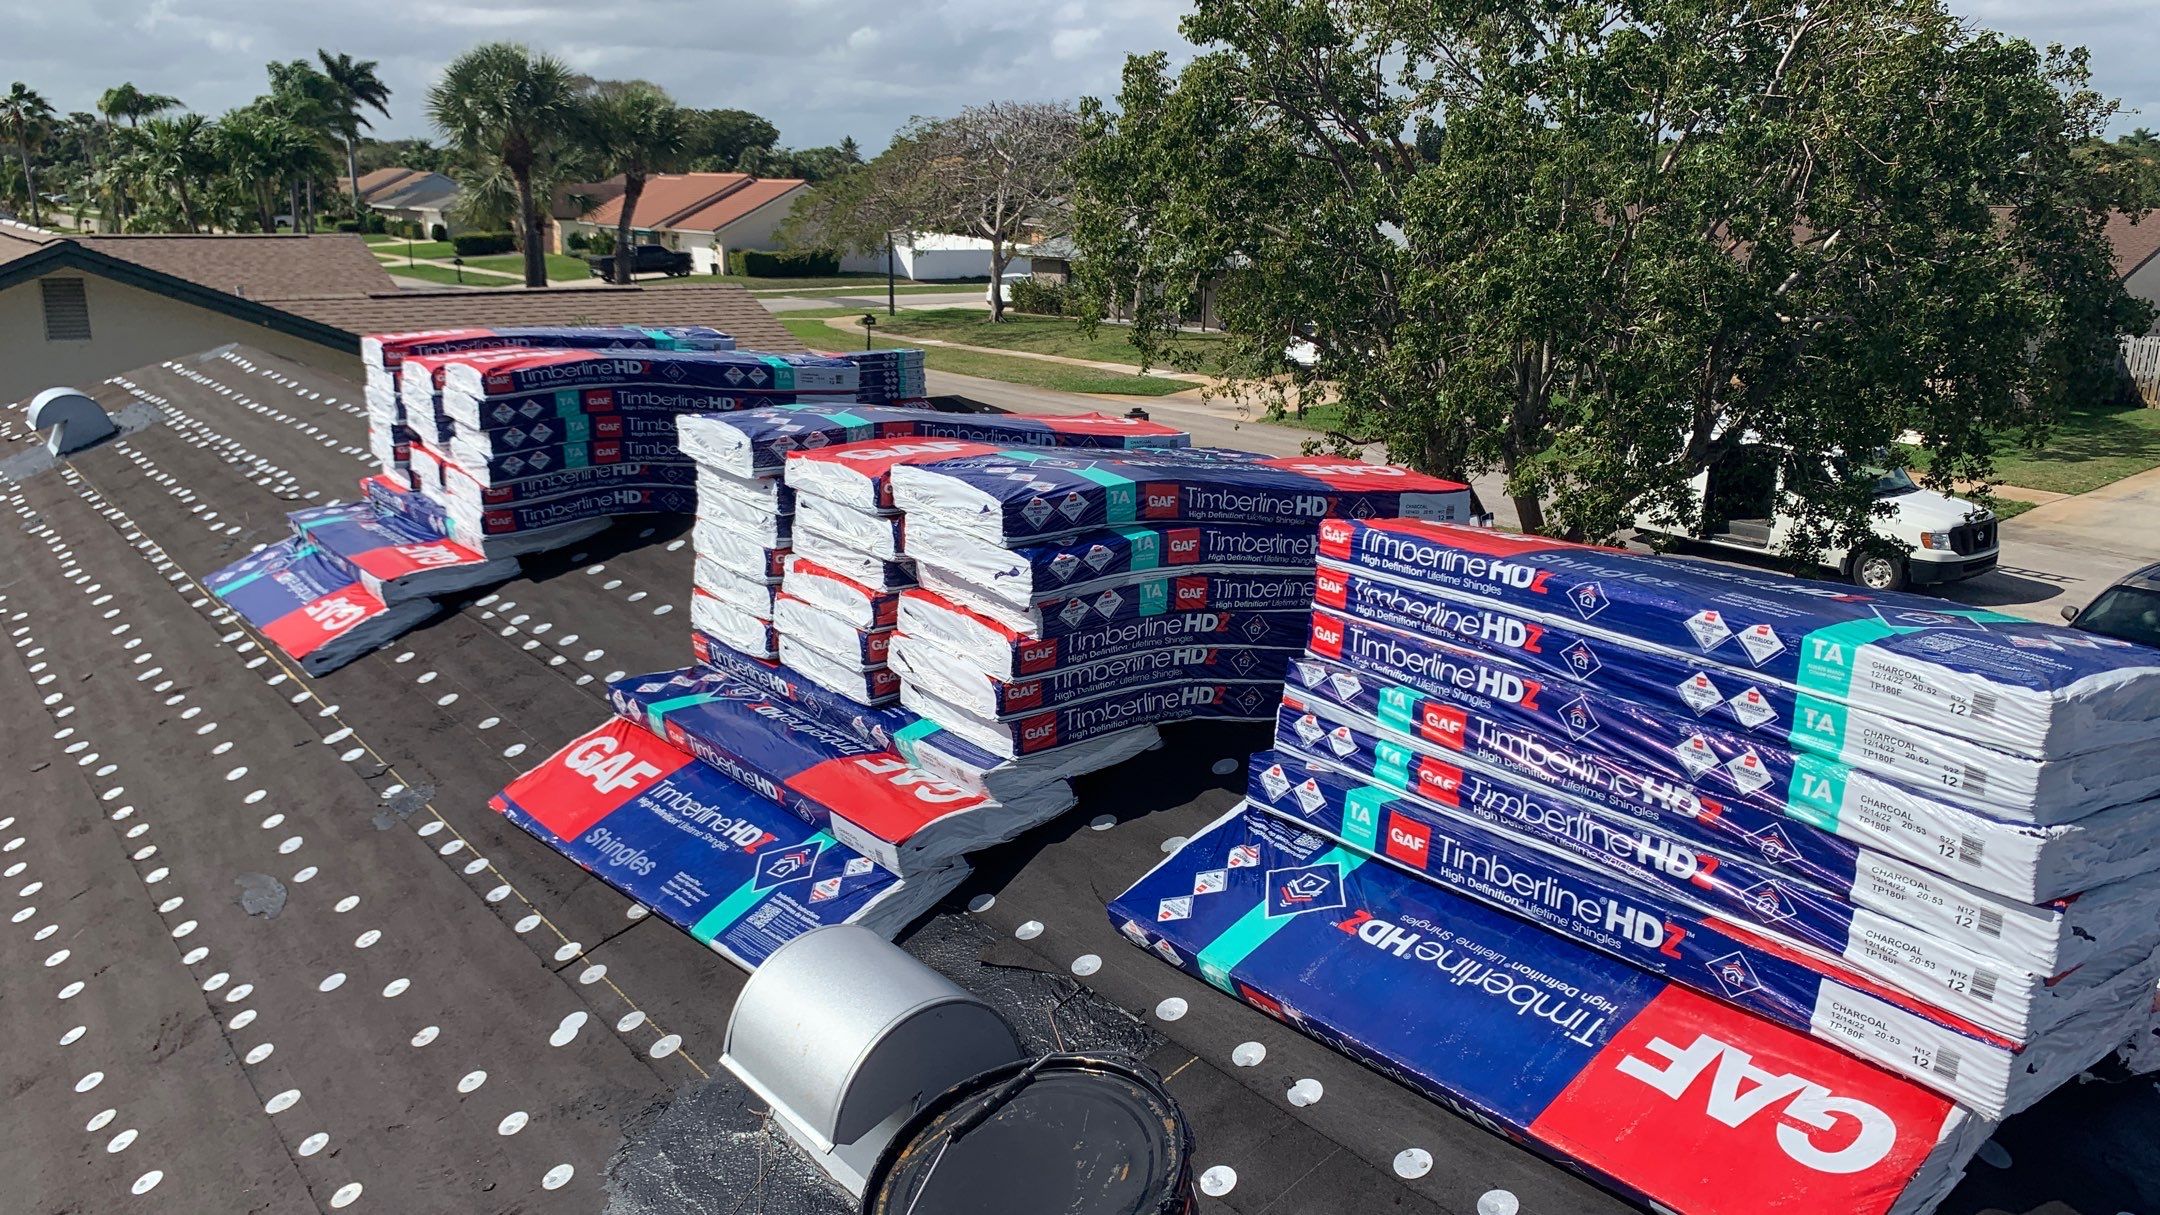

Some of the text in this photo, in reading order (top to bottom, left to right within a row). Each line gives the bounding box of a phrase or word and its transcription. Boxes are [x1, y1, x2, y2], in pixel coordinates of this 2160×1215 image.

[588, 397, 612, 406] GAF
[598, 424, 620, 432] GAF
[597, 448, 618, 457] GAF
[835, 441, 970, 461] GAF
[1111, 491, 1131, 505] TA
[1148, 495, 1176, 508] GAF
[489, 516, 513, 526] GAF
[1171, 540, 1197, 552] GAF
[1322, 526, 1349, 545] GAF
[1361, 553, 1380, 567] High
[1463, 577, 1502, 596] Shingles
[1529, 553, 1681, 588] Shingles
[1144, 584, 1163, 599] TA
[1179, 588, 1205, 600] GAF
[1318, 577, 1345, 595] GAF
[1356, 603, 1376, 618] High
[1313, 626, 1340, 645] GAF
[1023, 647, 1054, 662] GAF
[1812, 639, 1844, 666] TA
[1872, 660, 1925, 683] CHARCOAL
[1007, 684, 1039, 700] GAF
[1869, 680, 1903, 697] TP180F
[1870, 670, 1938, 697] 12/14/22 20:52
[1386, 689, 1406, 711] TA
[1949, 703, 1967, 717] 12
[1024, 723, 1054, 740] GAF
[1425, 712, 1463, 735] GAF
[1804, 708, 1836, 738] TA
[1863, 728, 1918, 754] CHARCOAL
[564, 736, 663, 794] GAF
[1381, 744, 1401, 766] TA
[1862, 748, 1896, 765] TP180F
[1419, 769, 1456, 793] GAF
[1801, 772, 1833, 804] TA
[1940, 773, 1959, 788] 12
[1350, 800, 1371, 826] TA
[1609, 791, 1661, 822] Shingles
[1860, 794, 1915, 822] CHARCOAL
[1858, 814, 1892, 833] TP180F
[1859, 803, 1928, 836] 12/14/22 20:53
[1390, 827, 1425, 851] GAF
[585, 827, 657, 876] Shingles
[1937, 844, 1956, 859] 12
[1871, 866, 1932, 892] CHARCOAL
[1441, 866, 1465, 885] High
[1571, 916, 1622, 949] Shingles
[1916, 891, 1944, 906] 20:53
[1399, 913, 1456, 944] Shingles
[1953, 913, 1974, 929] 12
[1865, 929, 1925, 957] CHARCOAL
[1863, 938, 1937, 971] 12/14/22 20:53
[1949, 967, 1969, 981] N1Z
[1946, 977, 1967, 993] 12
[1580, 991, 1618, 1015] High
[1831, 1000, 1890, 1032] CHARCOAL
[1827, 1019, 1866, 1041] TP180F
[1830, 1010, 1902, 1047] 12/14/22 20:53
[1910, 1053, 1931, 1070] 12
[1914, 1044, 1933, 1058] N1Z
[1615, 1033, 1897, 1174] GAF
